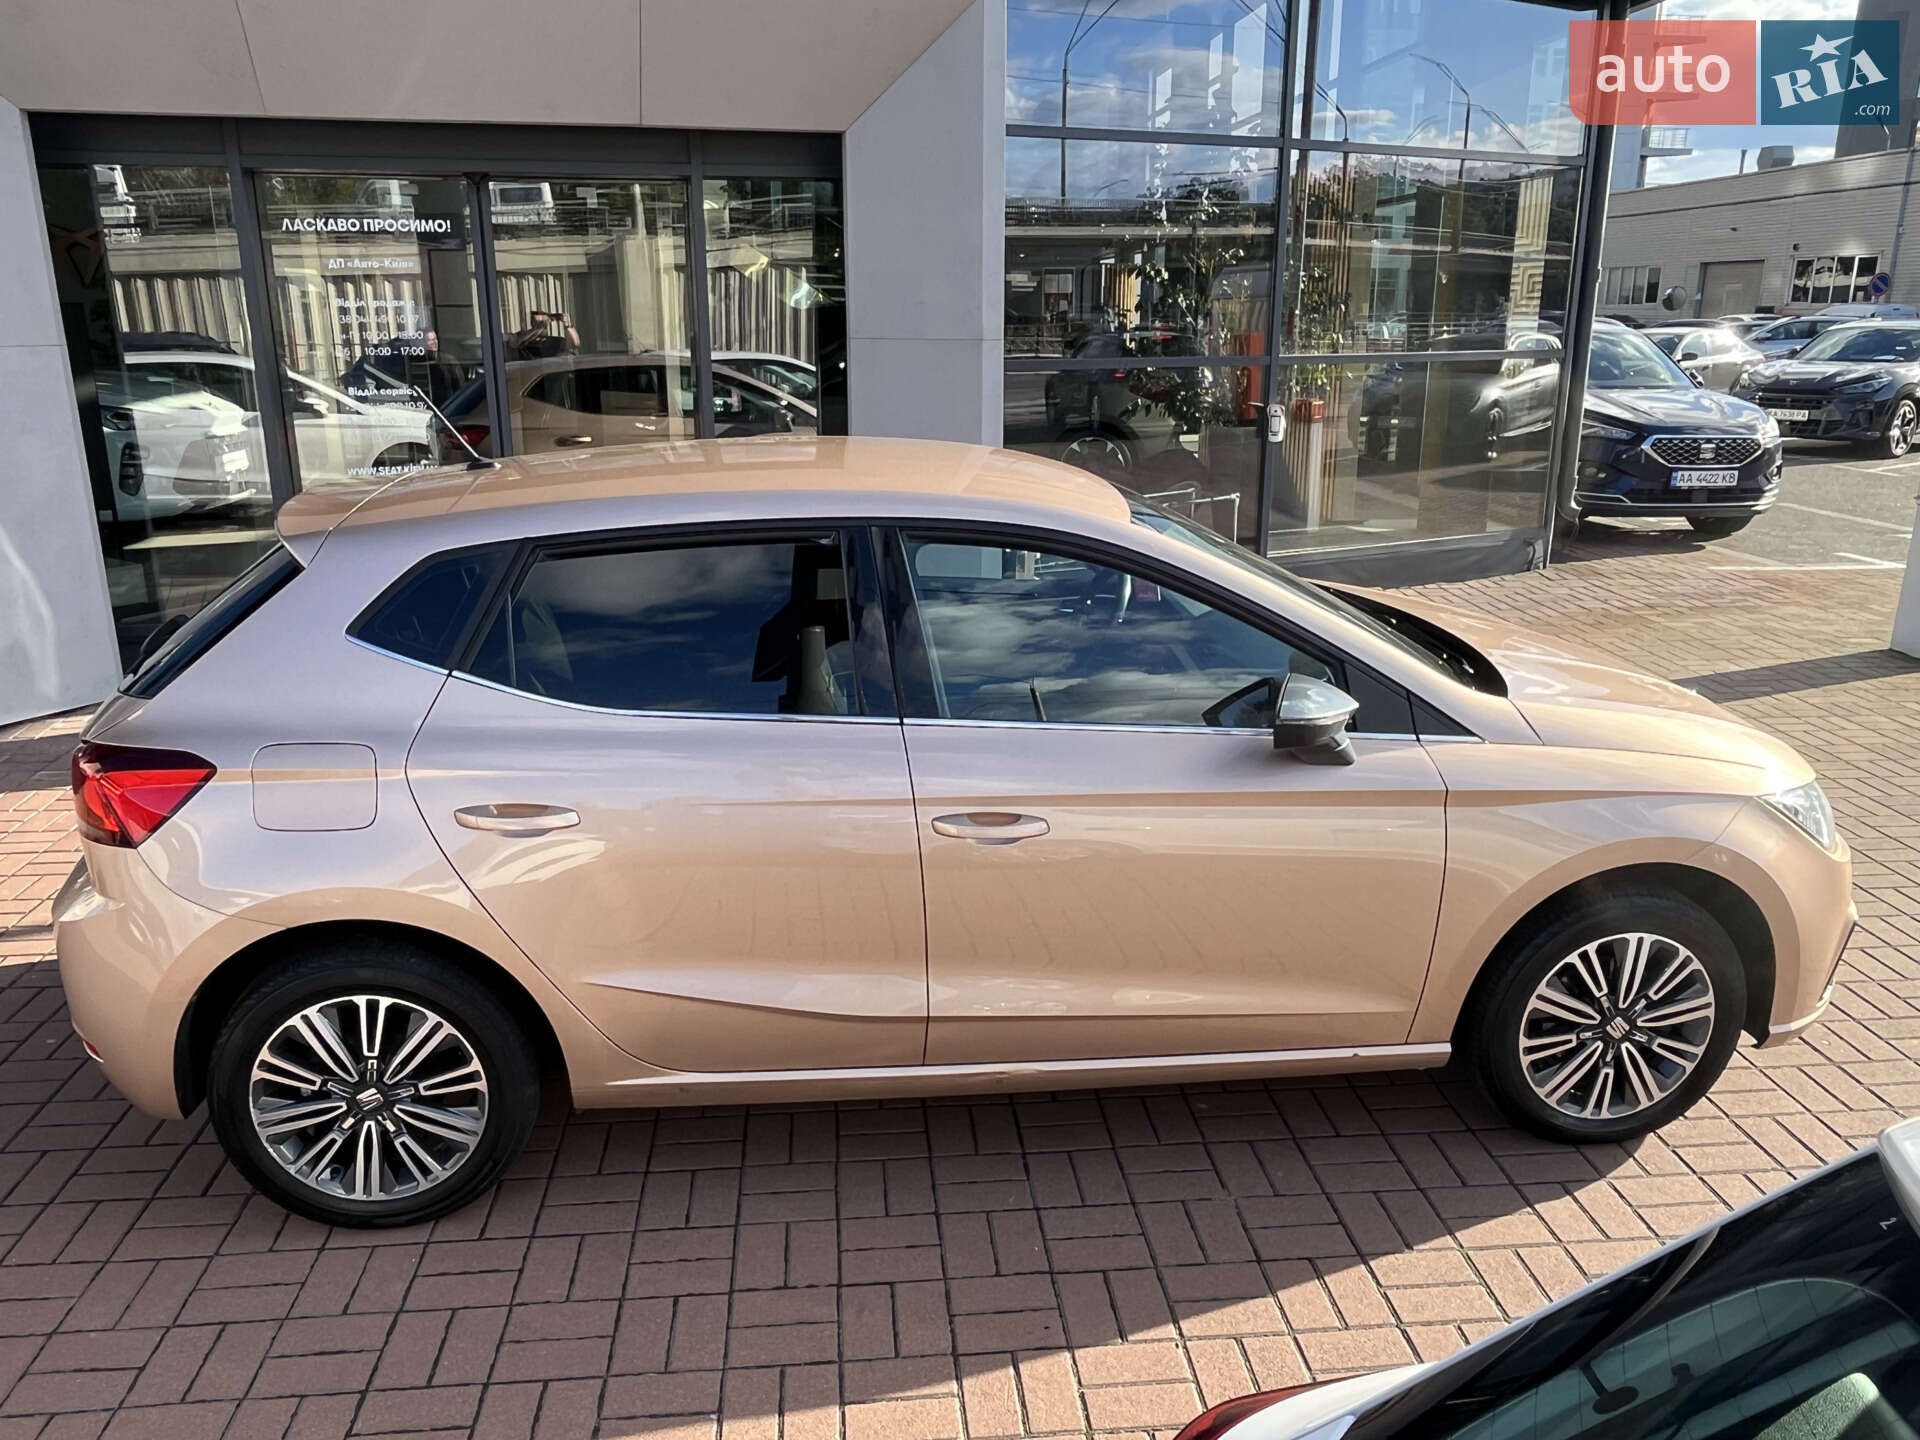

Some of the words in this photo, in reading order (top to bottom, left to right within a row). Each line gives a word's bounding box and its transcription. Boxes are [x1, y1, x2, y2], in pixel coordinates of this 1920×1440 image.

[281, 217, 360, 232] ЛАСКАВО
[363, 218, 452, 233] ПРОСИМО!
[328, 258, 345, 270] ДП
[364, 346, 391, 356] 10:00
[400, 346, 425, 356] 17:00
[1678, 472, 1694, 485] AA
[1695, 472, 1720, 485] 4422
[1721, 472, 1737, 485] KB
